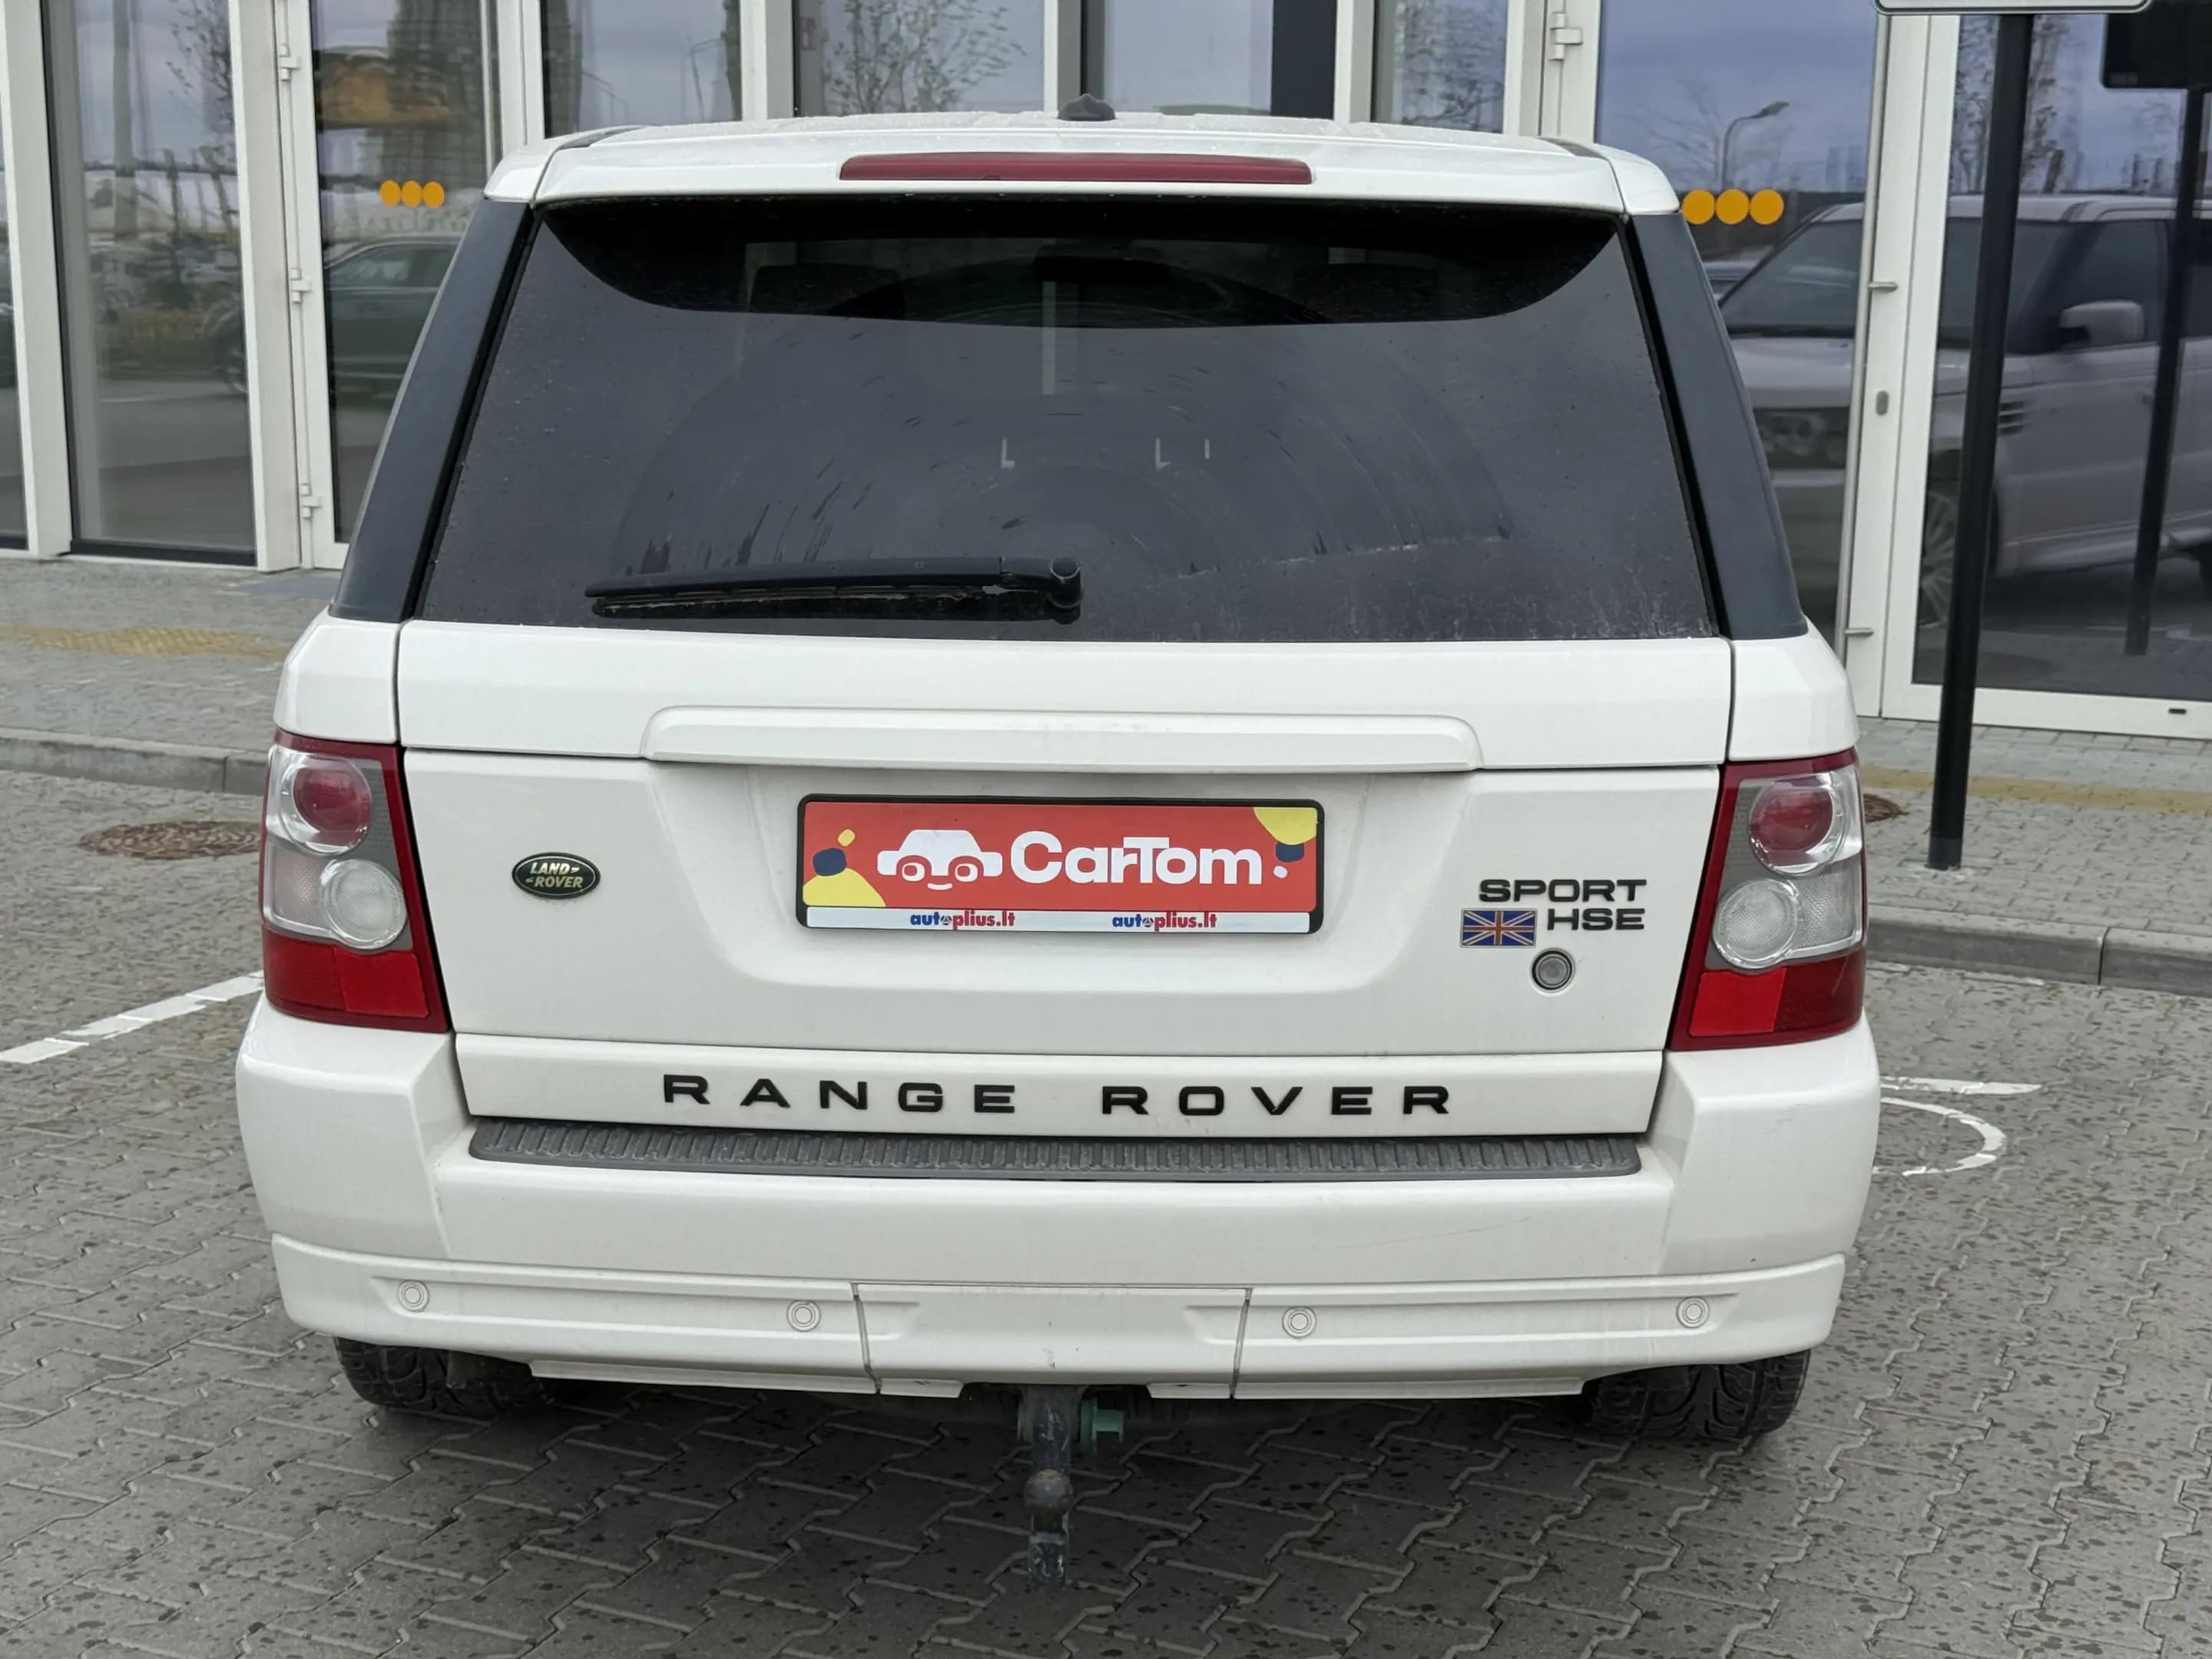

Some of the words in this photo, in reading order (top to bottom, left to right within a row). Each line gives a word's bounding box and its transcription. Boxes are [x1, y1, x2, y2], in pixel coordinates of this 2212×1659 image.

[530, 862, 571, 875] LAND
[1010, 830, 1263, 885] CarTom
[534, 876, 584, 889] ROVER
[1479, 879, 1647, 902] SPORT
[1547, 908, 1645, 931] HSE
[663, 1074, 1015, 1114] RANGE
[1101, 1085, 1449, 1117] ROVER
